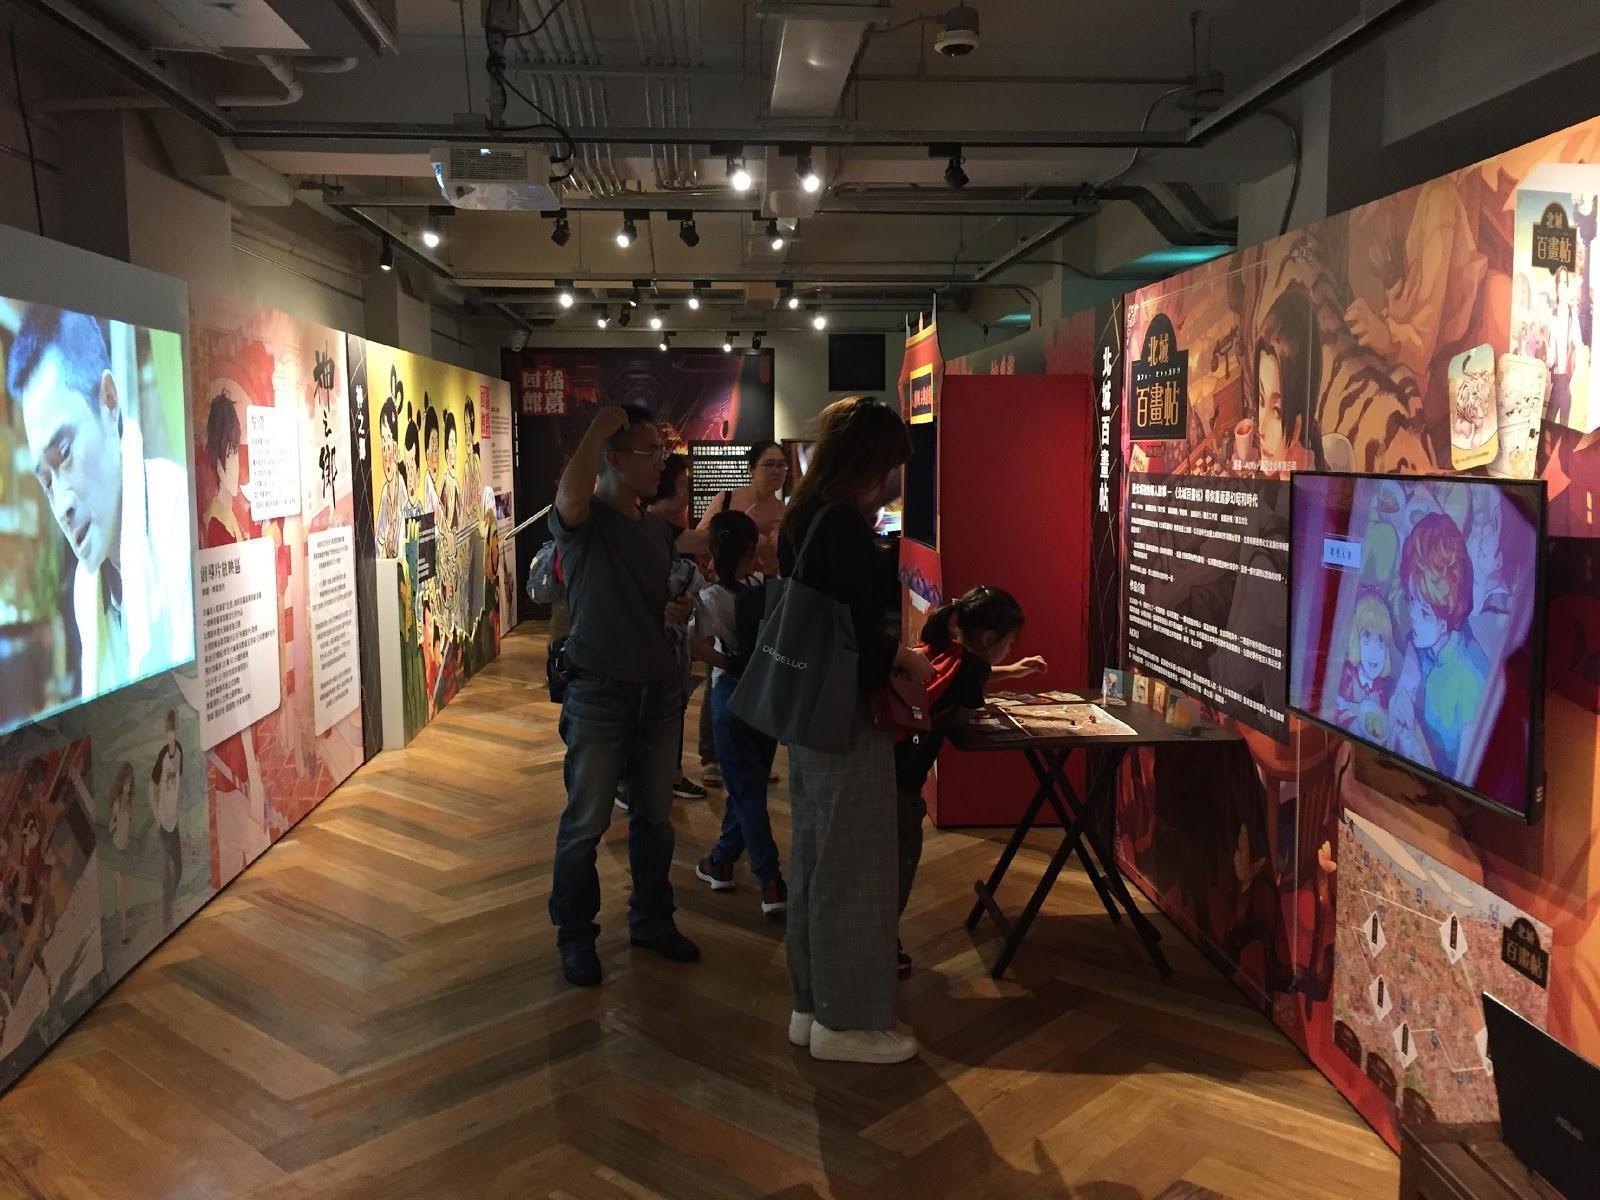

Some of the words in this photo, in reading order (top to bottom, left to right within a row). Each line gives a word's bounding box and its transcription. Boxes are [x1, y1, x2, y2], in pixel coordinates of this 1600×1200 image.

[1148, 333, 1169, 367] 北城
[1136, 380, 1180, 428] 百畫帖
[1099, 345, 1112, 513] 北城百畫帖
